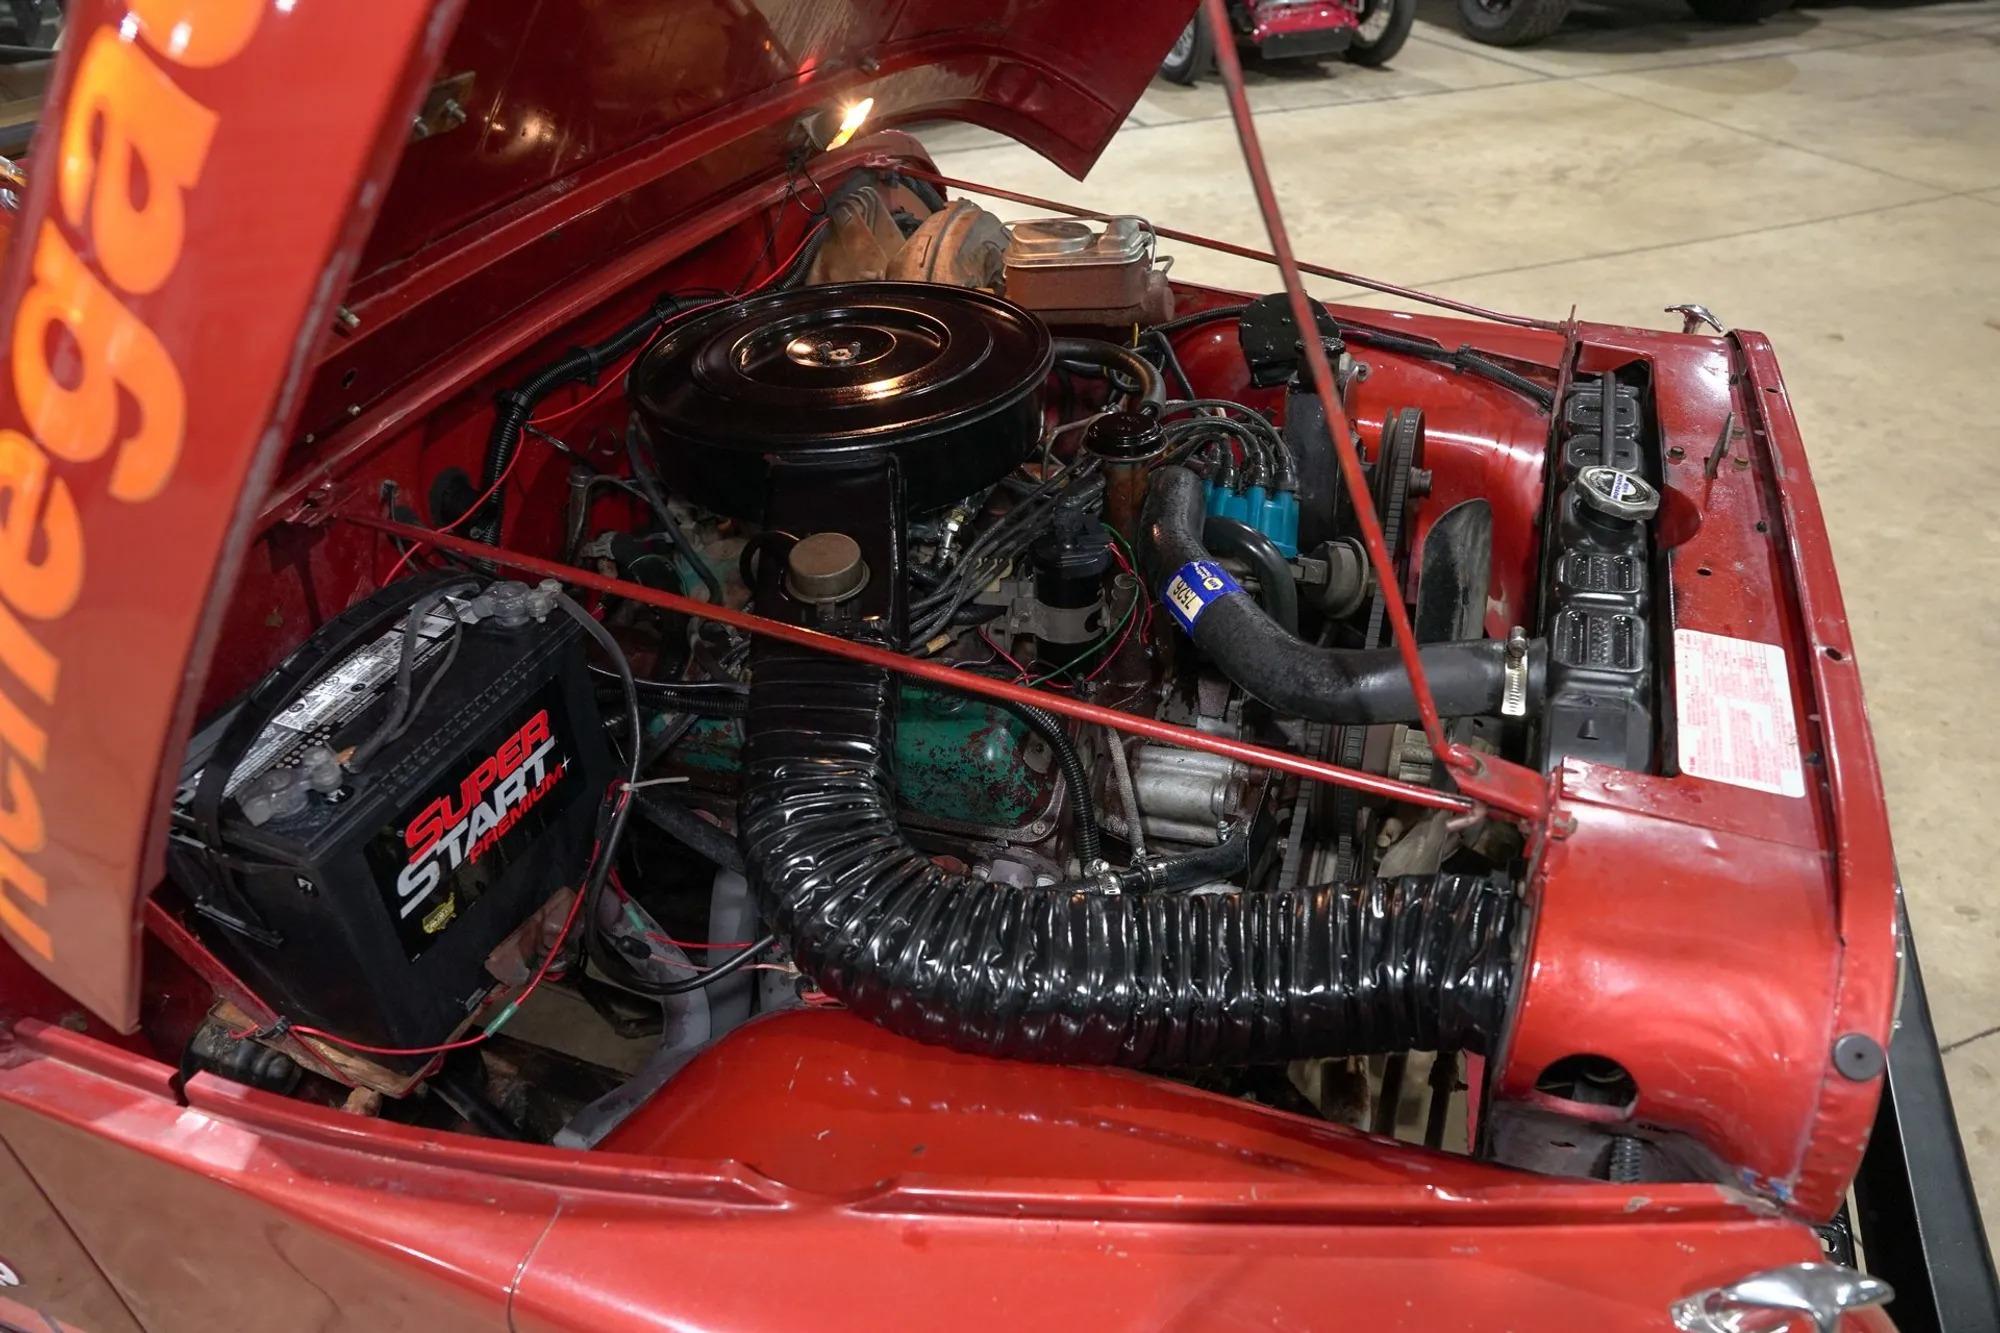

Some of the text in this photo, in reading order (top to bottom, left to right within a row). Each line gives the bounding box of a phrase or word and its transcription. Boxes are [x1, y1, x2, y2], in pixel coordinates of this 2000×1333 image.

[1173, 580, 1197, 610] 7526
[397, 735, 555, 919] START
[405, 709, 549, 864] SUPER
[468, 763, 564, 864] PREMIUM
